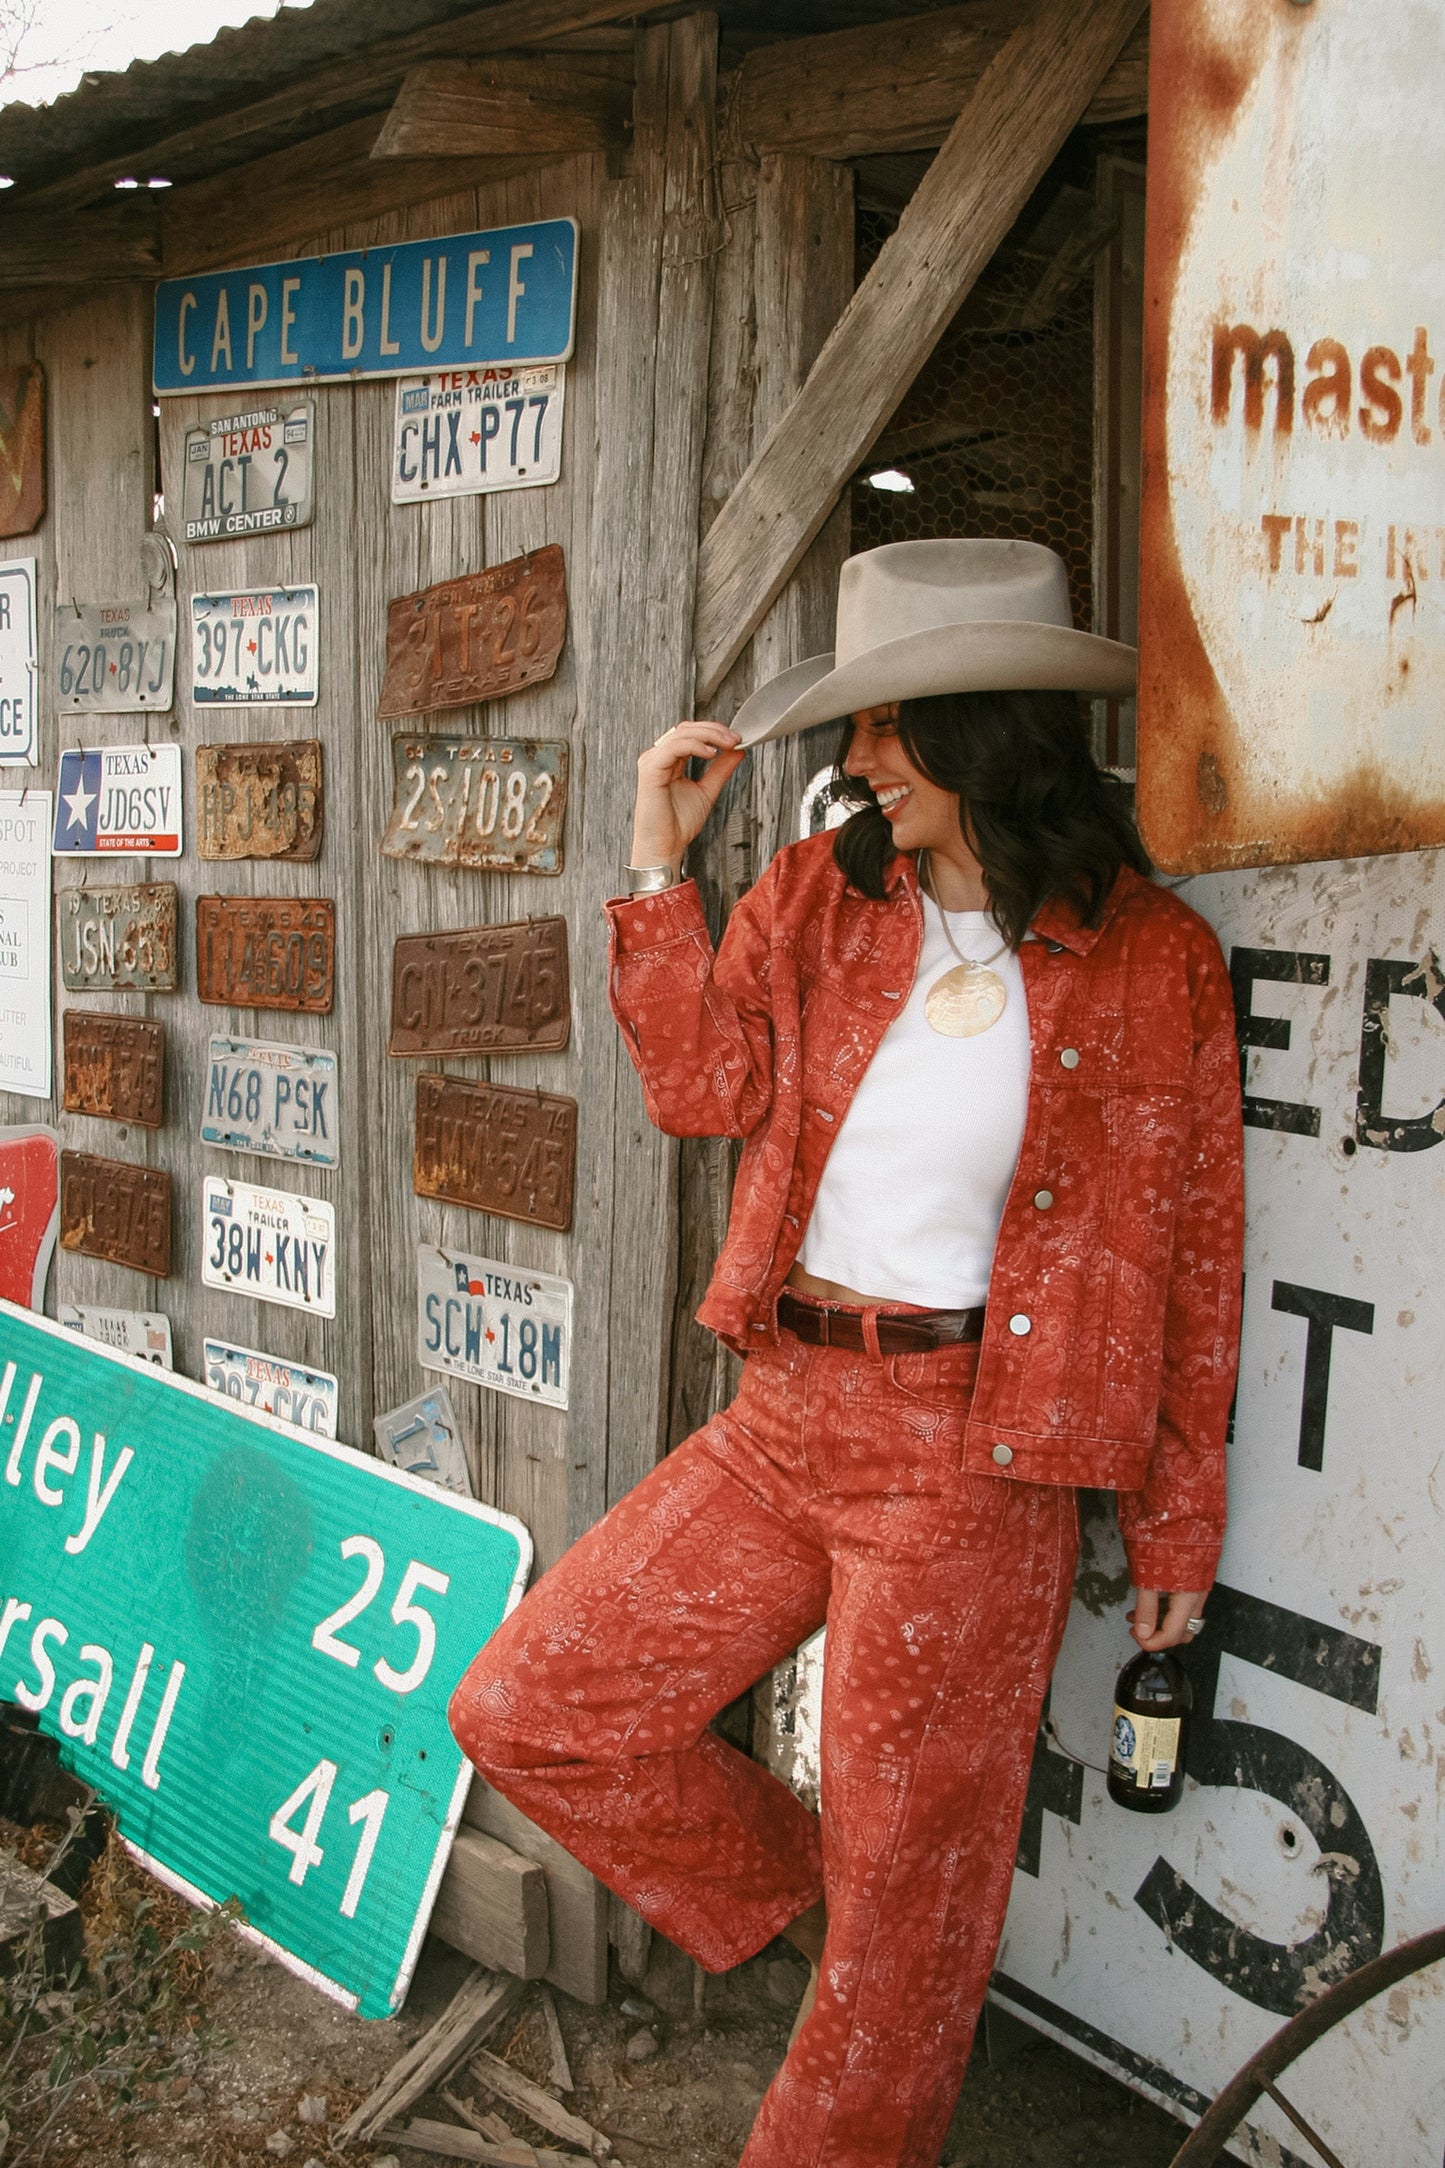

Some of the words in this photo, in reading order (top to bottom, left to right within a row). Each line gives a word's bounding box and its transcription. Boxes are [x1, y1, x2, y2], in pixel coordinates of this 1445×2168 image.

[178, 277, 301, 376] CAPE
[341, 243, 534, 360] BLUFF
[431, 391, 462, 411] FARM
[468, 379, 520, 403] TRAILER
[438, 367, 514, 393] TEXAS
[1209, 323, 1445, 446] mast
[211, 419, 231, 435] SAN
[220, 425, 272, 458] TEXAS
[400, 410, 462, 483] CHX
[480, 395, 549, 473] P77
[191, 444, 208, 455] JAN
[201, 455, 252, 518] ACT
[273, 447, 289, 506] 2
[186, 518, 221, 539] BMW
[226, 508, 282, 532] CENTER
[1261, 514, 1359, 578] THE
[99, 608, 131, 623] TEXAS
[230, 594, 273, 618] TEXAS
[99, 626, 129, 639] TRUCK
[493, 585, 541, 667] 26
[196, 620, 245, 678] 397
[257, 614, 308, 675] CKG
[60, 643, 107, 696] 620
[118, 640, 166, 694] 8YJ
[431, 667, 511, 697] TEXAS
[106, 753, 149, 776] TEXAS
[446, 747, 514, 763] TEXAS
[400, 764, 449, 832] 2S
[457, 766, 553, 843] 1082
[99, 838, 116, 848] STATE
[116, 838, 124, 847] OF
[124, 837, 135, 848] THE
[136, 837, 150, 848] ARTS
[95, 892, 141, 915] TEXAS
[228, 907, 292, 930] TEXAS
[67, 919, 116, 976] JSN
[444, 933, 514, 953] TEXAS
[266, 929, 327, 999] 609
[400, 958, 449, 1029] CN
[461, 947, 560, 1025] 3745
[450, 1026, 506, 1044] TRUCK
[208, 1064, 262, 1123] N68
[275, 1074, 329, 1140] PSK
[252, 1194, 286, 1214] TEXAS
[248, 1210, 289, 1231] TRAILER
[209, 1217, 262, 1282] 38W
[275, 1231, 327, 1300] KNY
[485, 1273, 534, 1306] TEXAS
[99, 1318, 127, 1333] TEXAS
[424, 1292, 483, 1366] SCW
[497, 1312, 562, 1388] 18M
[245, 1356, 291, 1388] TEXAS
[452, 1360, 466, 1372] THE
[466, 1363, 485, 1379] LONE
[486, 1370, 504, 1385] STAR
[505, 1375, 528, 1391] STATE
[1226, 1271, 1375, 1473] T
[310, 1535, 452, 1694] 25
[0, 1597, 186, 1790] rsall
[268, 1759, 391, 1920] 41
